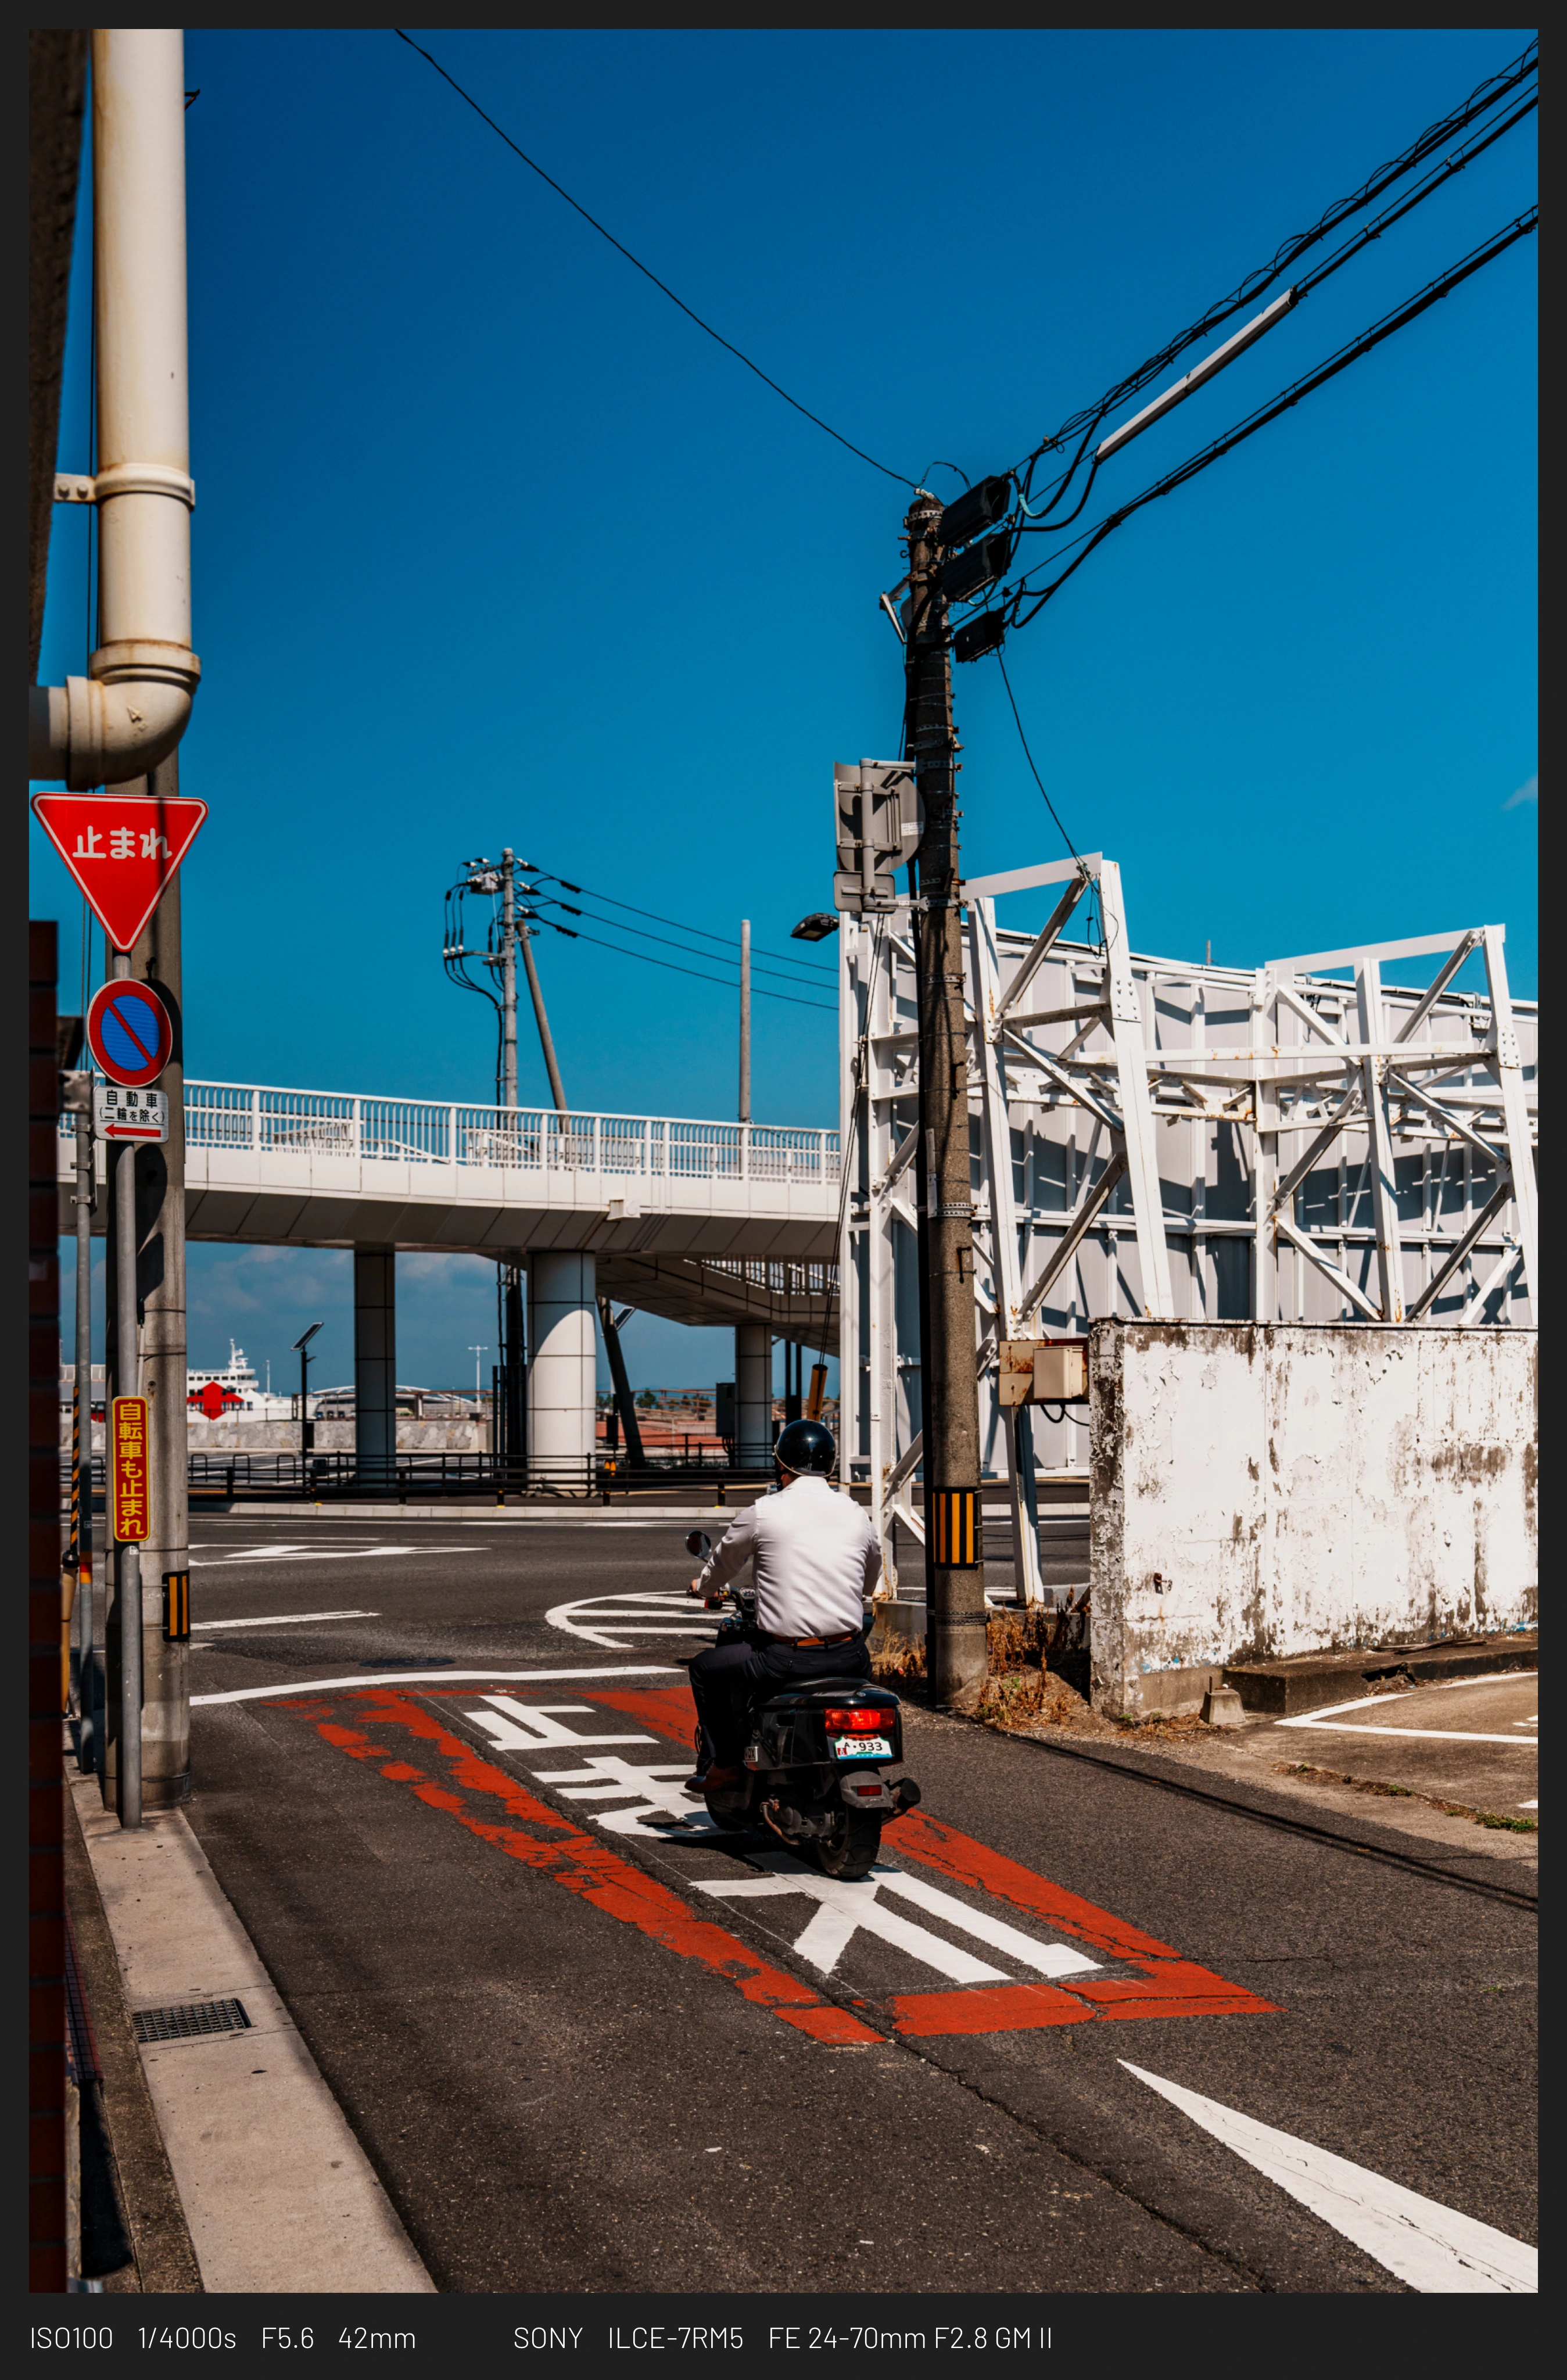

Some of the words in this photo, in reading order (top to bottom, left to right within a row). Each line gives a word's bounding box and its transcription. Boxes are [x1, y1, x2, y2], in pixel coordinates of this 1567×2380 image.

[72, 825, 173, 860] 止まれ
[106, 1089, 157, 1109] 自動車
[118, 1402, 145, 1536] 自転車も止まれ
